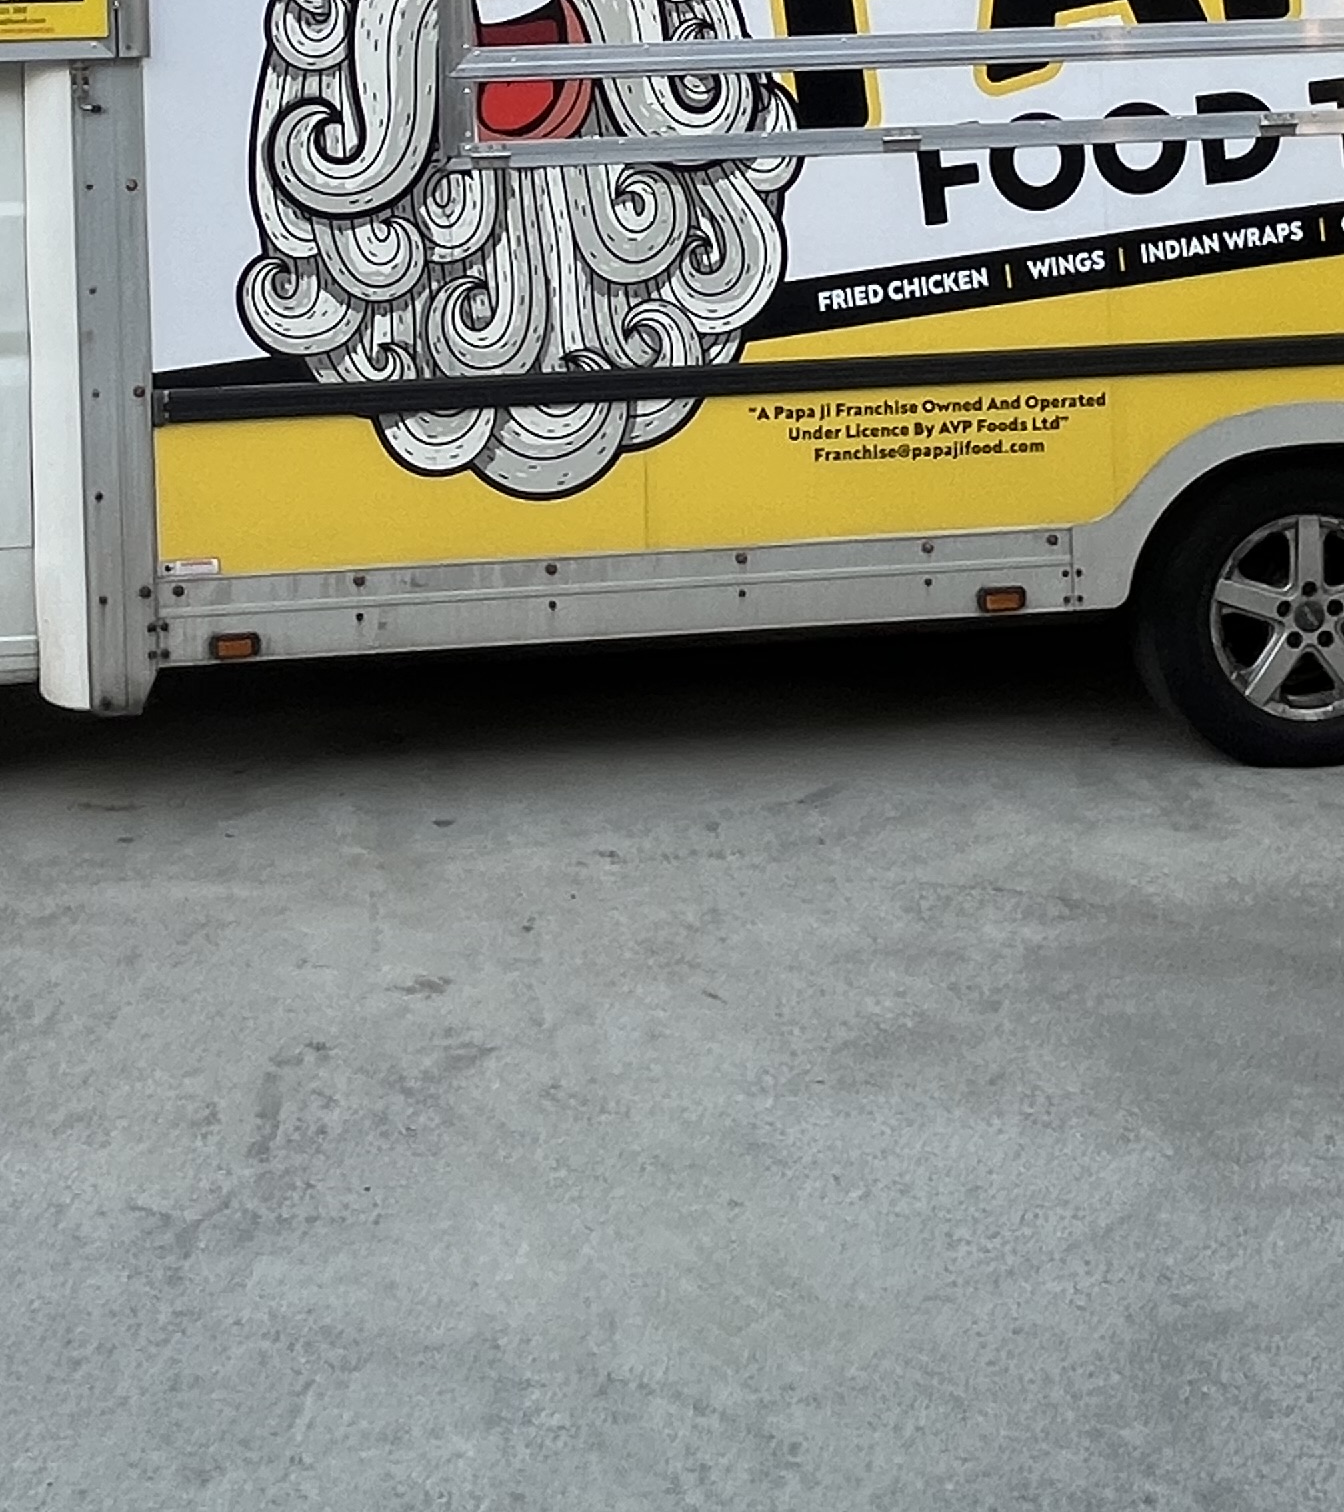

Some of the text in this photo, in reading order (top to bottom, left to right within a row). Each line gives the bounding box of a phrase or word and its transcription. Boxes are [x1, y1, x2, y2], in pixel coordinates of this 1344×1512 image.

[916, 91, 1281, 225] FOOD
[1140, 222, 1304, 265] INDIAN WRAPS
[1027, 251, 1105, 280] WINGS
[818, 267, 989, 312] FRIED CHICKEN
[774, 407, 815, 422] Papa
[836, 399, 918, 417] Franchise
[922, 397, 982, 413] Owned
[987, 395, 1021, 411] And
[1025, 392, 1106, 411] Operated
[788, 425, 841, 440] Under
[846, 422, 909, 438] Licence
[914, 421, 934, 437] By
[977, 417, 1027, 433] Foods
[814, 439, 1045, 462] Franchise@papajifood.com
